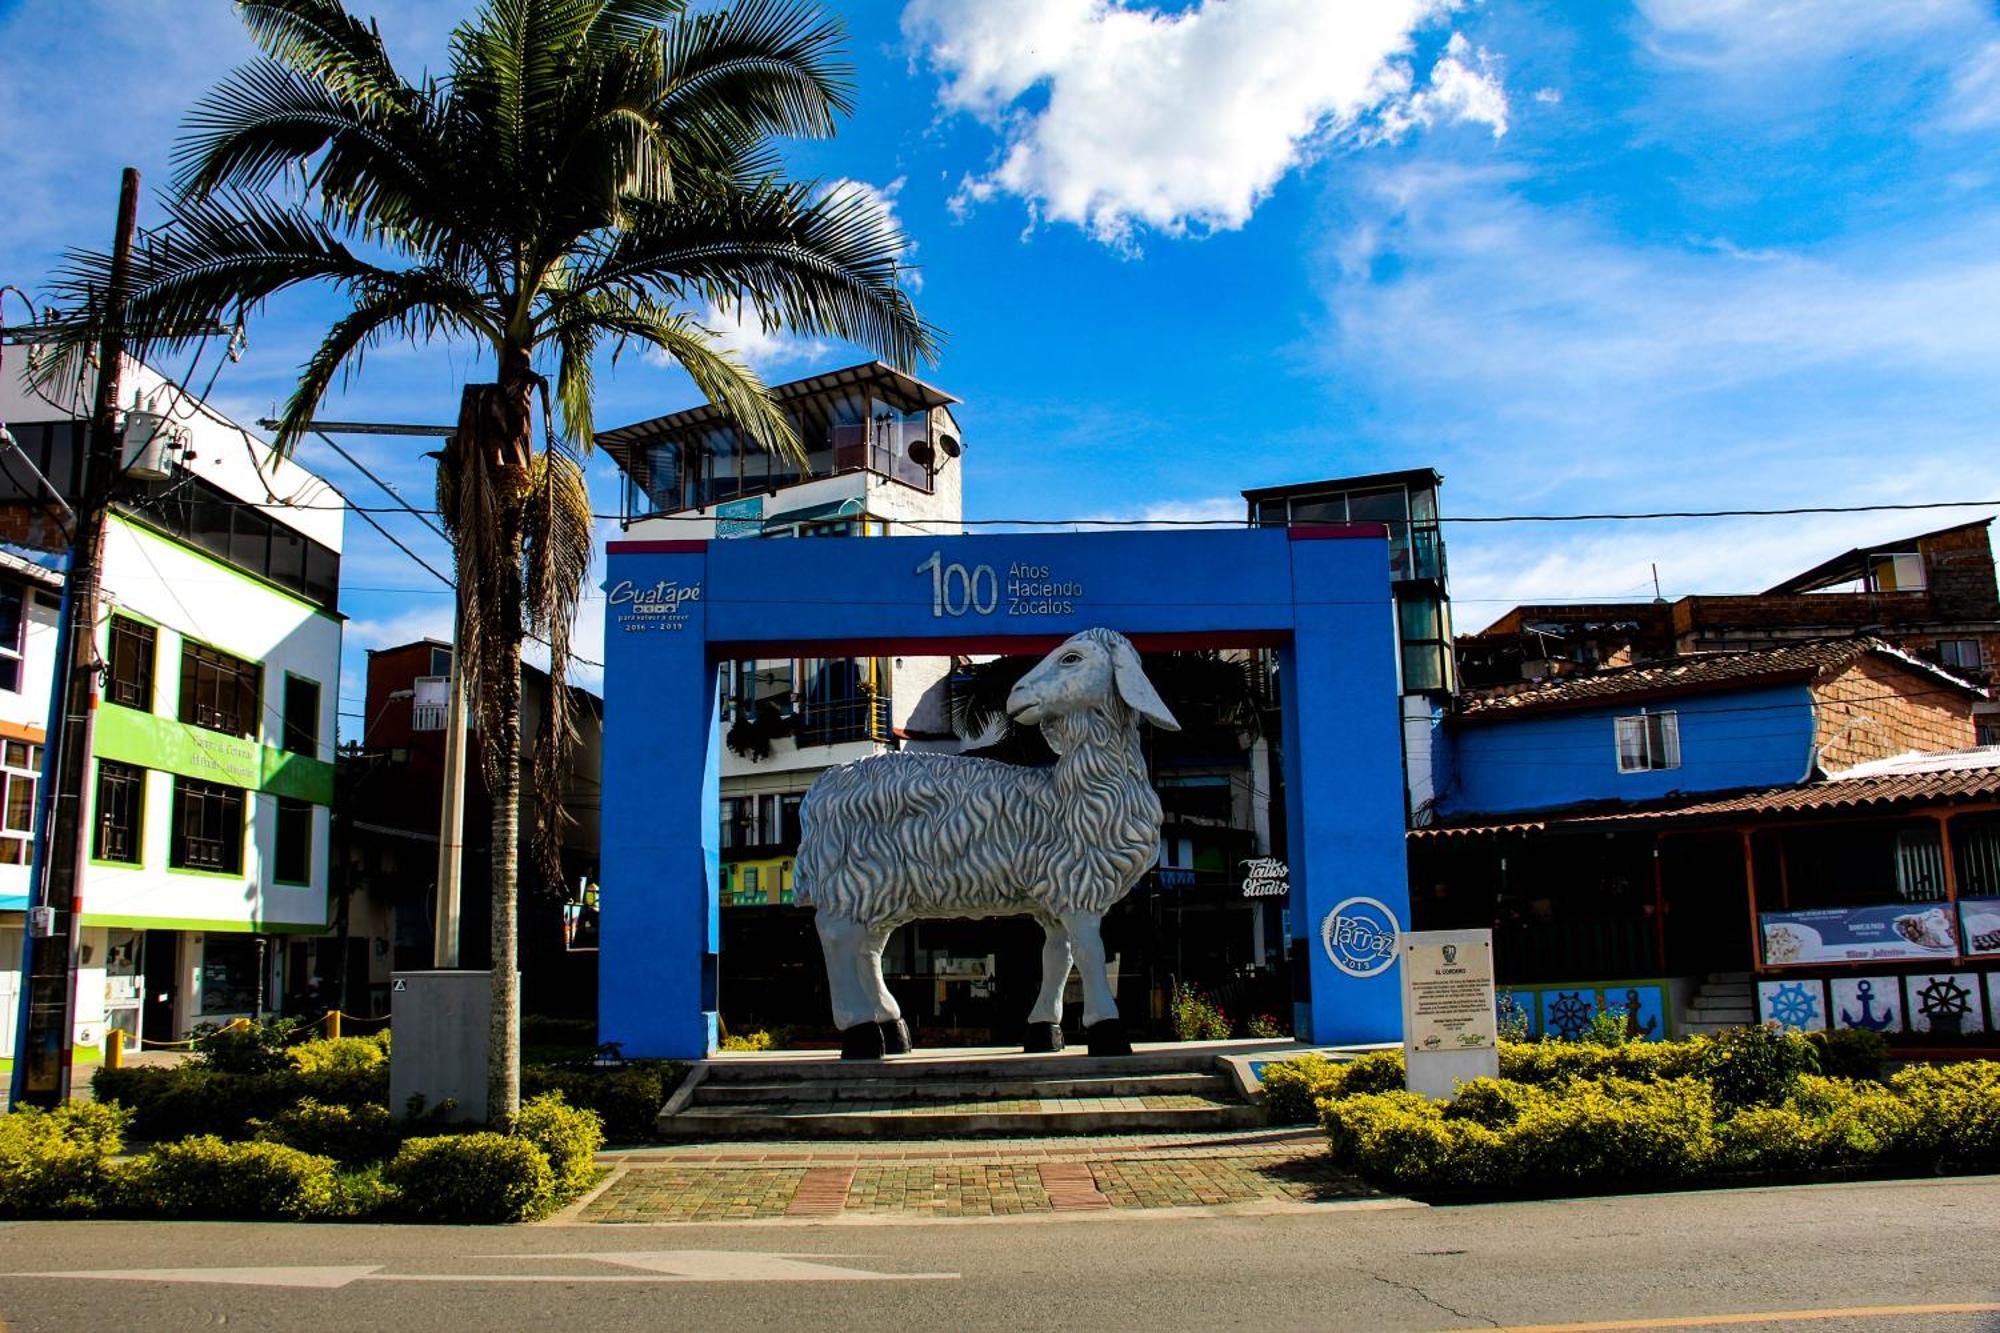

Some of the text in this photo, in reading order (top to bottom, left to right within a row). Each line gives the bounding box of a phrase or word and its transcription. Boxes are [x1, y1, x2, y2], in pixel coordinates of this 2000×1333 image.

[1009, 561, 1049, 578] Años
[916, 550, 999, 617] 100
[1008, 579, 1082, 597] Haciendo
[609, 580, 700, 608] Guatapé
[1242, 878, 1290, 897] Studio
